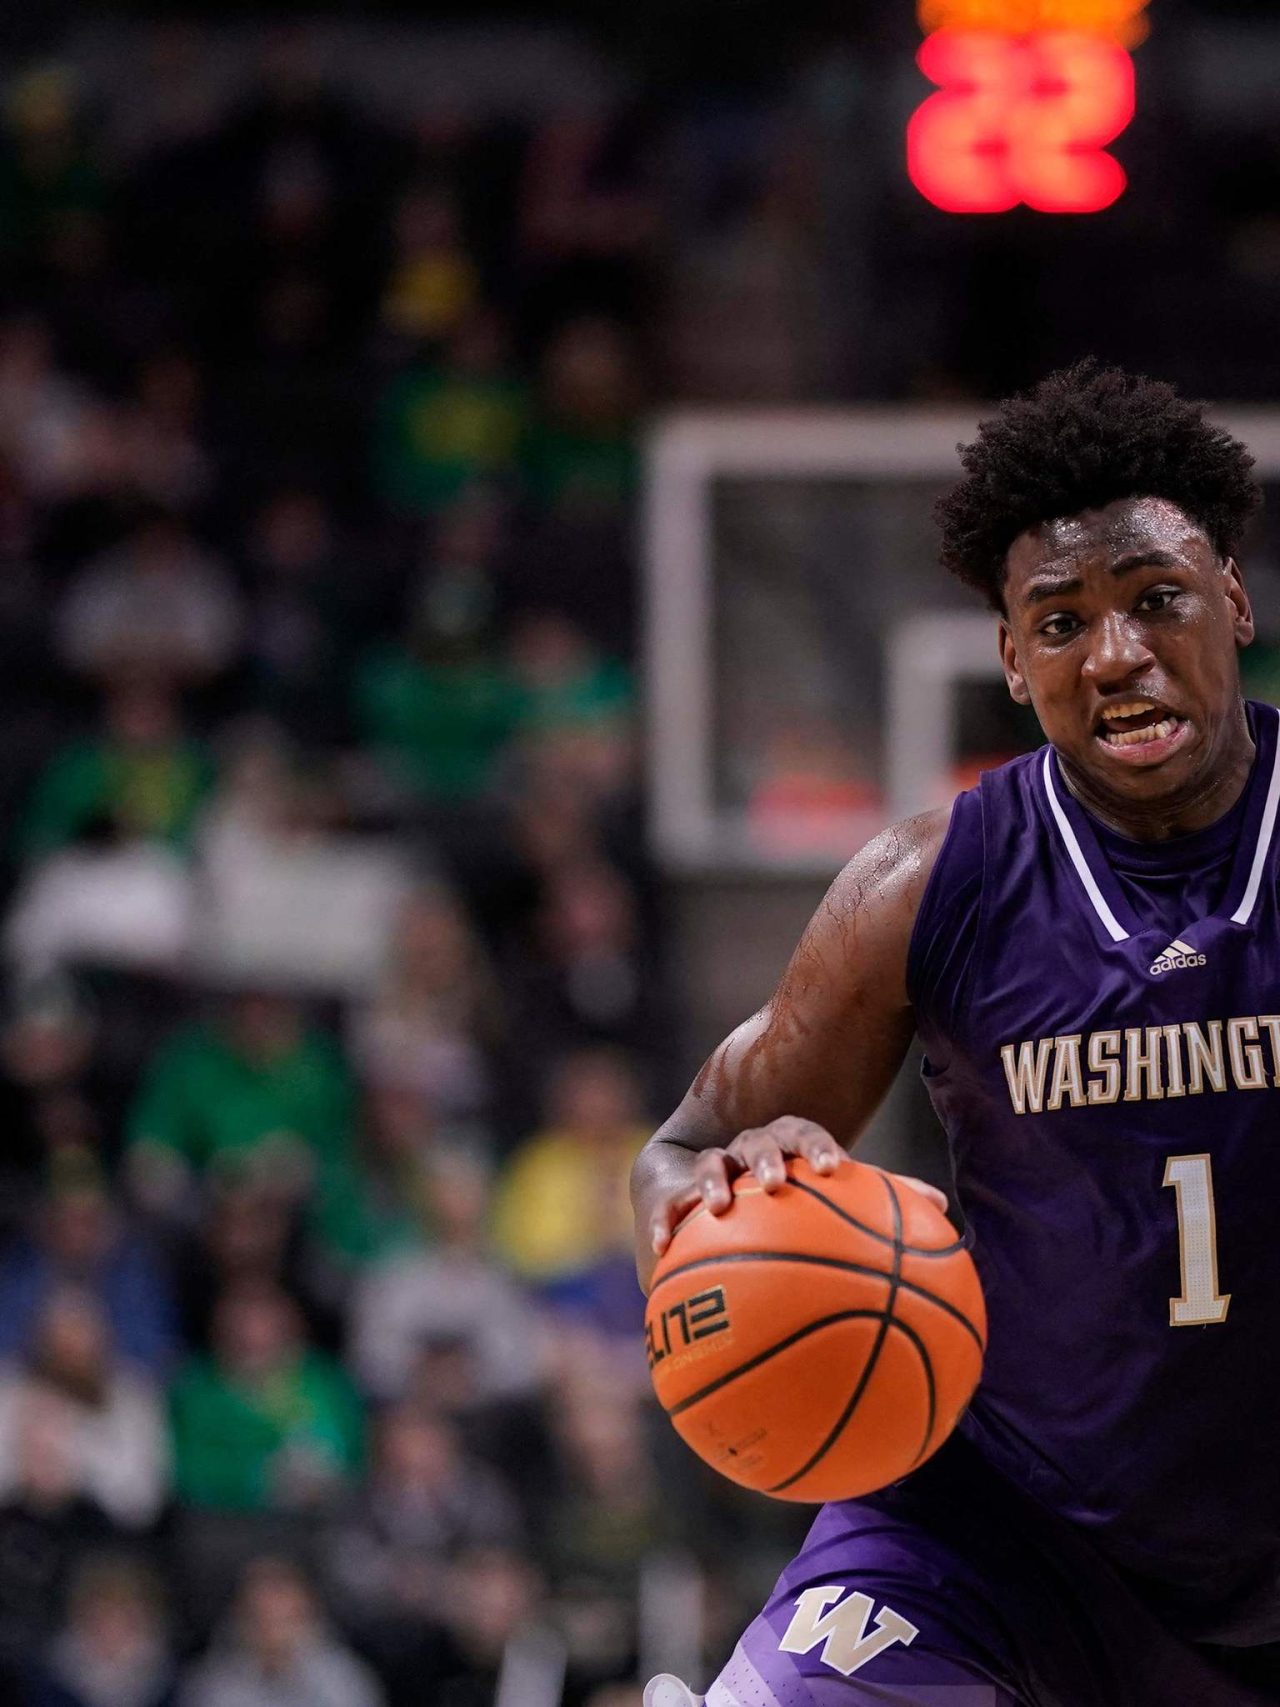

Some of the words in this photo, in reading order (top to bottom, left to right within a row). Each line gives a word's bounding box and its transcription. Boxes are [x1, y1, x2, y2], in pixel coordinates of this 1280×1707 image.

[1150, 953, 1207, 975] adidas
[1162, 1153, 1231, 1326] 1
[778, 1586, 919, 1676] W
